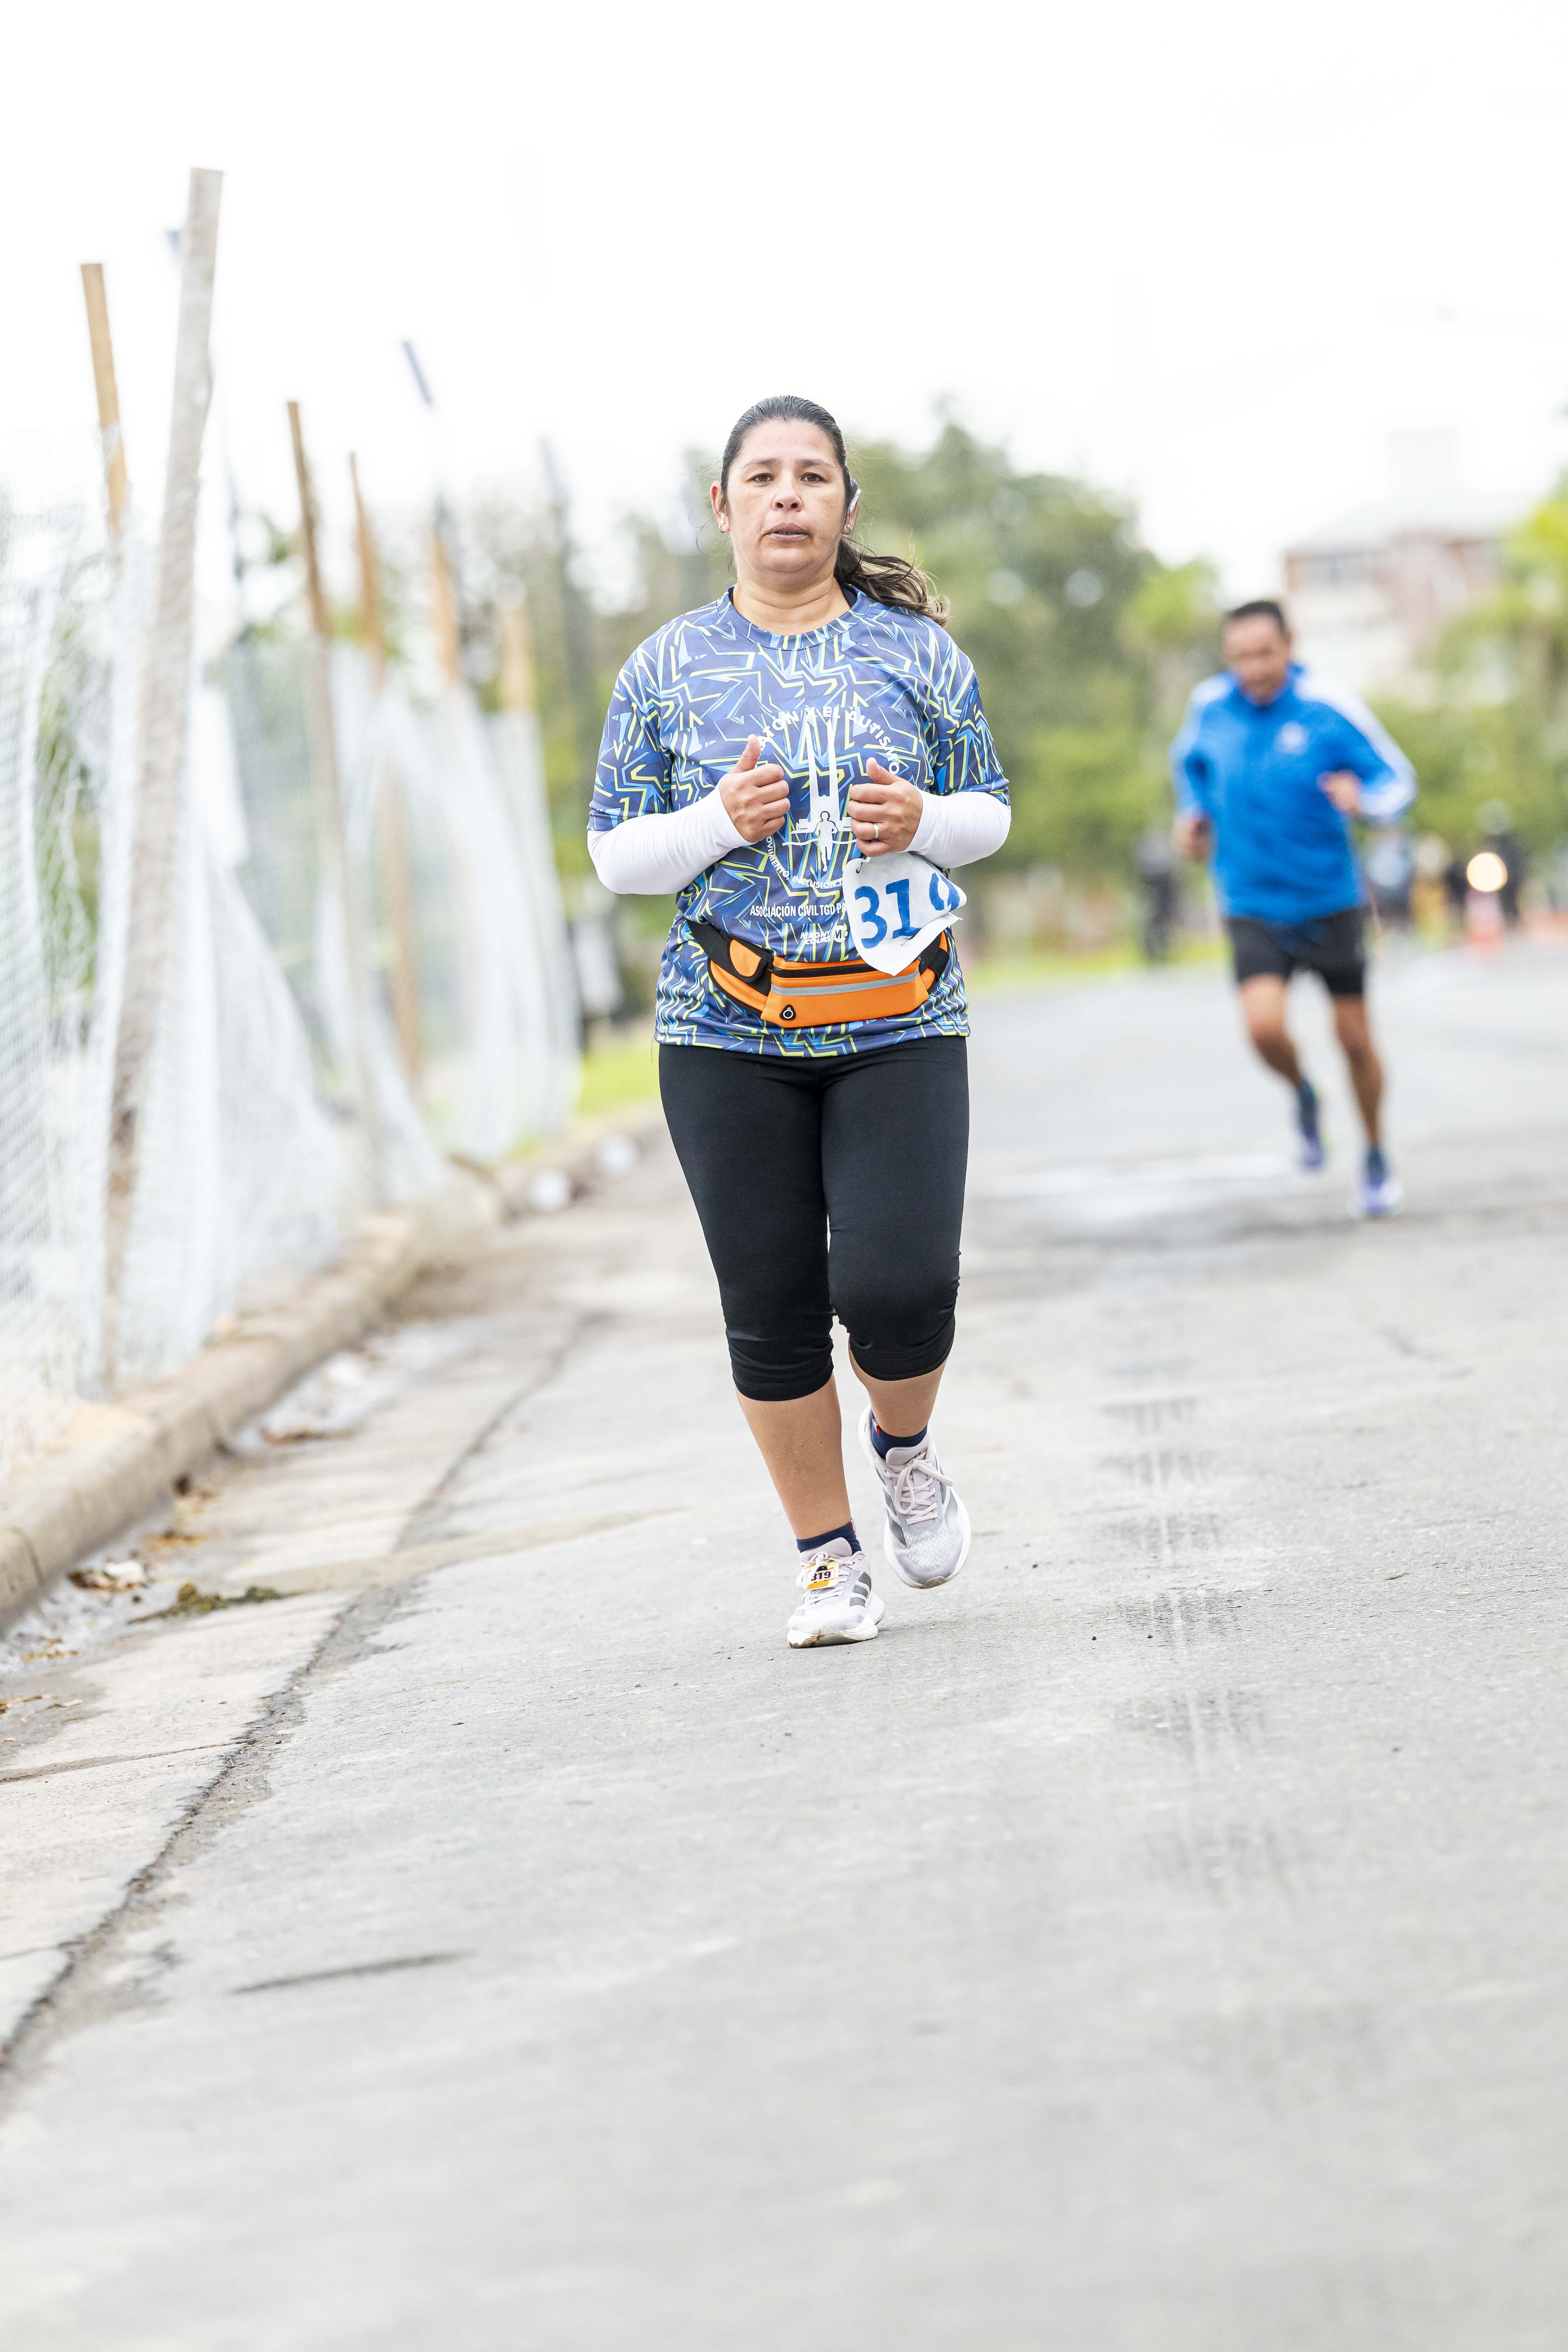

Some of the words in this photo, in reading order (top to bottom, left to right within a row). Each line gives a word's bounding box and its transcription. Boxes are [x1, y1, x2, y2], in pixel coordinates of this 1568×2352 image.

[822, 706, 841, 719] EL
[845, 710, 900, 775] AUTISMO
[766, 836, 789, 880] OVIMIENTO,
[792, 875, 836, 889] INCLUSIÓN
[750, 902, 796, 917] ASOCIACIÓN
[798, 905, 819, 917] CIVIL
[819, 904, 835, 916] TGD
[800, 929, 831, 939] MAGNY
[805, 936, 831, 945] COURS
[811, 1571, 831, 1581] 319
